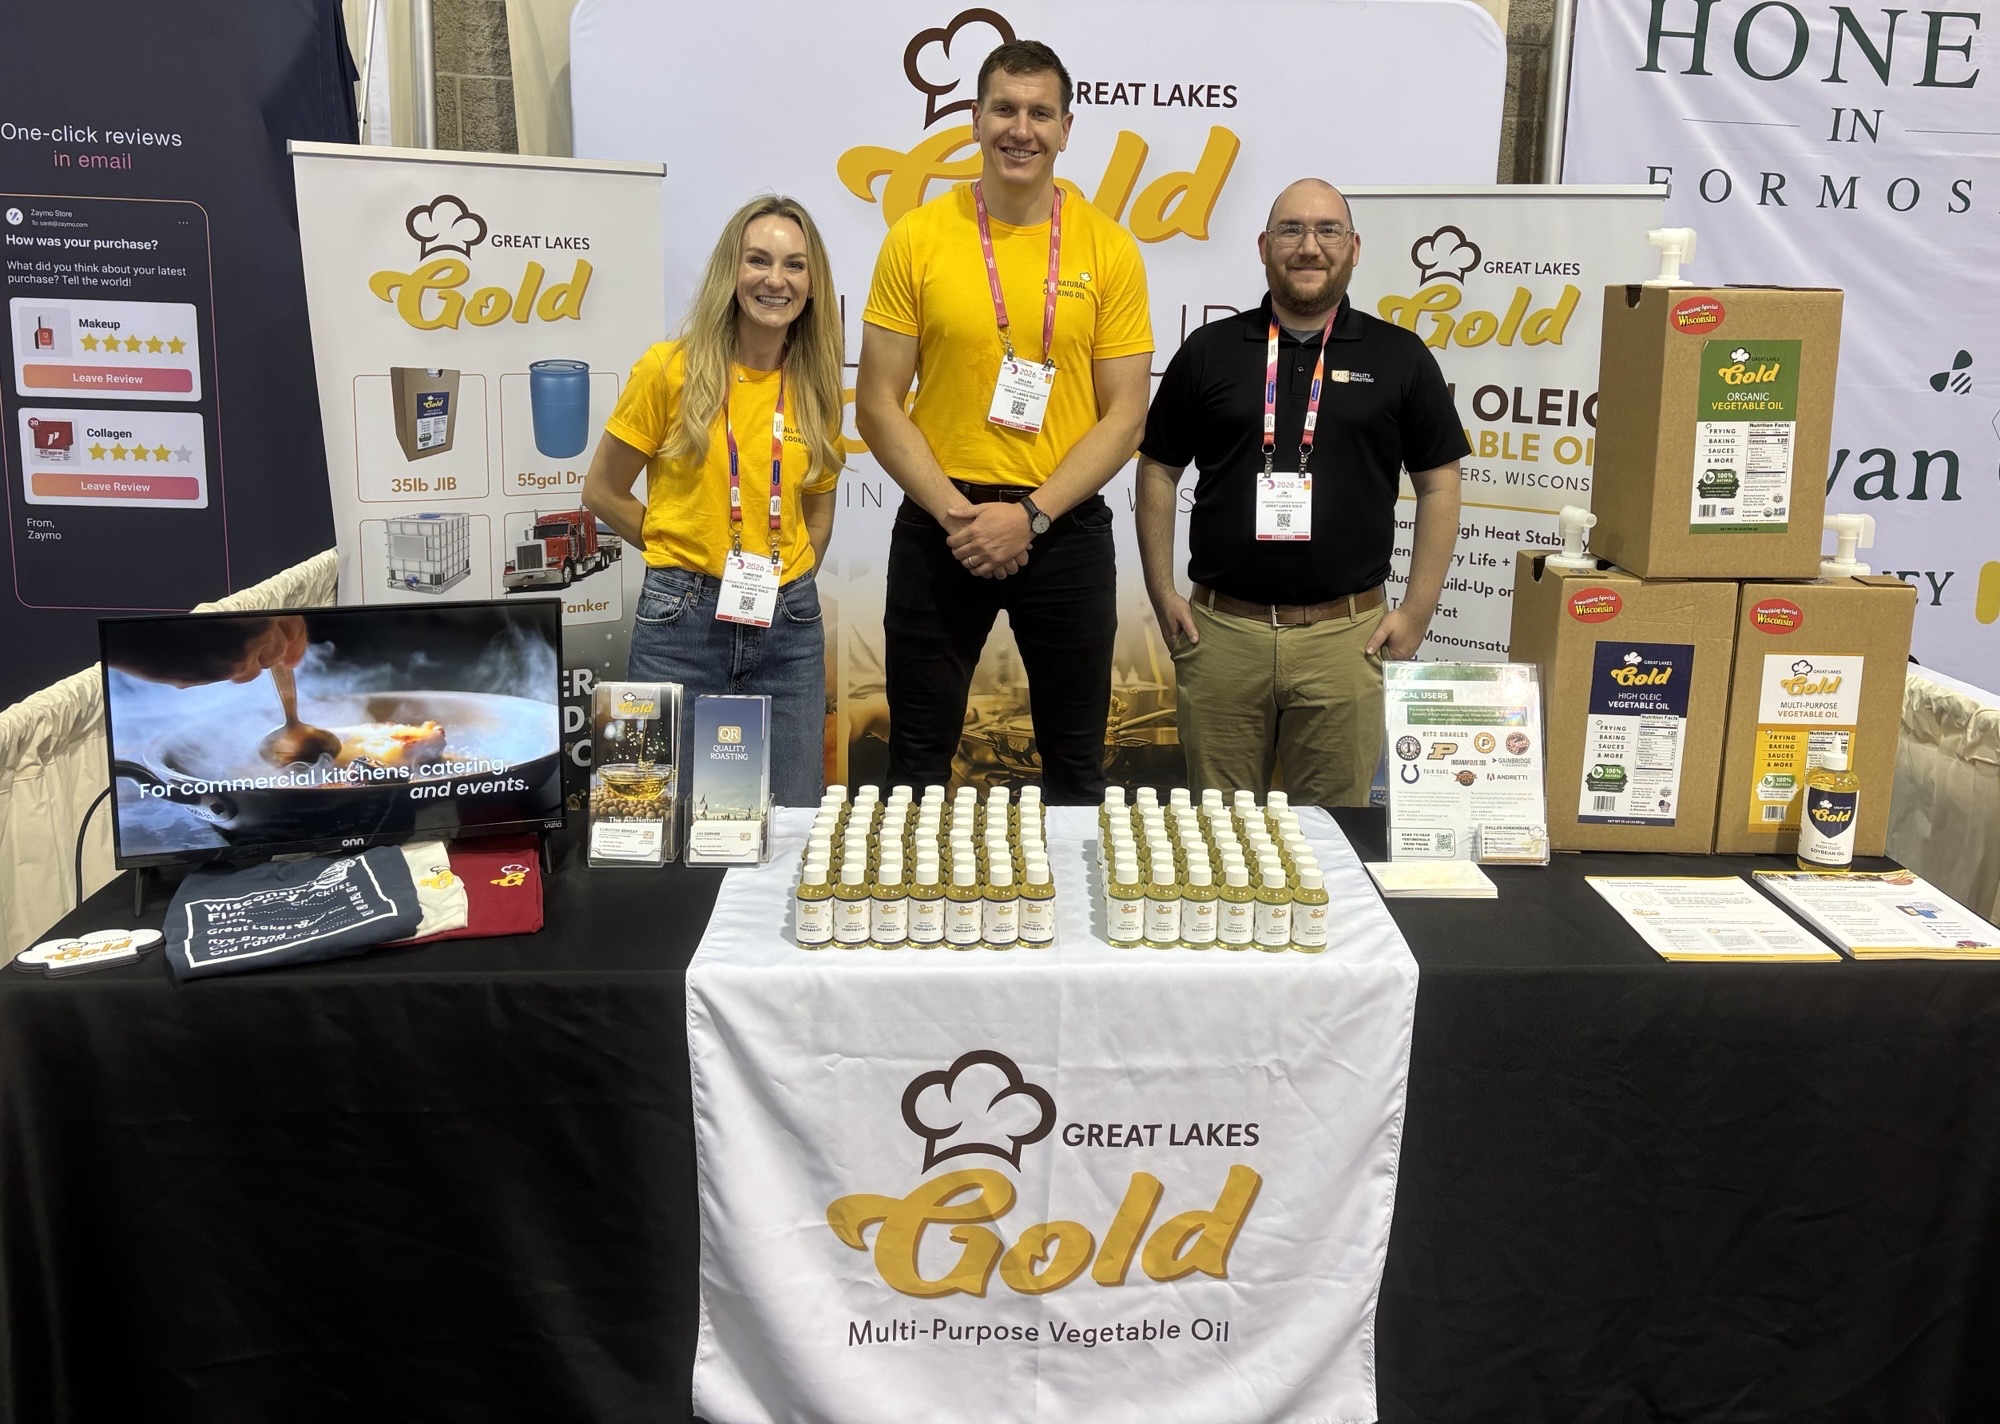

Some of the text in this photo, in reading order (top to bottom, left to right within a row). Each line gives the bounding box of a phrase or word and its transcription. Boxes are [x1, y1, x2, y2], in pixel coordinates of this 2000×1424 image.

[1635, 0, 1981, 89] HONE
[1072, 81, 1238, 109] REAT LAKES
[1826, 107, 1884, 144] IN
[1, 122, 183, 147] One-click reviews
[53, 150, 132, 169] in email
[836, 124, 1240, 243] Gld
[30, 208, 73, 219] Zaymo Store
[5, 234, 159, 250] How was your purchase?
[491, 234, 590, 250] GREAT LAKES
[6, 260, 187, 277] What did you think about your latest
[1483, 261, 1580, 276] GREAT LAKES
[7, 274, 132, 287] purchase? Tell the world!
[368, 257, 593, 331] Gold
[1043, 288, 1074, 299] CKING
[1701, 303, 1719, 311] Special
[1377, 283, 1581, 350] Gold
[1678, 314, 1718, 327] Wisconsin
[78, 318, 121, 331] Makeup
[72, 372, 143, 384] Leave Review
[1019, 368, 1037, 378] 2026
[1718, 363, 1780, 385] Gold
[1727, 392, 1770, 401] ORGANIC
[1711, 402, 1784, 410] VEGETABLE OIL
[86, 428, 132, 440] Collagen
[80, 481, 151, 492] Leave Review
[391, 476, 457, 492] 35lb JIB
[517, 471, 561, 490] 55gal
[1505, 471, 1590, 492] WISCONS
[26, 518, 55, 529] From,
[27, 530, 62, 542] Zaymo
[1484, 525, 1520, 542] Heat
[1469, 551, 1497, 567] Life
[746, 562, 765, 572] 2026
[1435, 603, 1458, 619] Fat
[1575, 604, 1614, 617] Wisconsin
[1757, 613, 1794, 627] Wisconsin
[1424, 629, 1510, 653] Monounsatu
[1610, 666, 1673, 686] Gold
[1780, 675, 1842, 696] Gold
[1421, 692, 1448, 700] USERS
[1618, 692, 1662, 701] HIGH OLEIC
[617, 700, 655, 715] Gold
[1608, 701, 1670, 710] VEGETABLE OIL
[1780, 701, 1838, 710] MULTI-PURPOSE
[1778, 710, 1823, 718] VEGETABLE
[719, 728, 740, 742] QR
[712, 744, 746, 753] QUALITY
[710, 752, 748, 761] ROASTING
[138, 756, 511, 799] For commercial kitchens, catering,
[409, 778, 530, 800] and events.
[608, 816, 622, 824] The
[1811, 808, 1852, 822] Gold
[544, 821, 563, 829] VIZIO
[341, 837, 364, 847] onn
[206, 923, 294, 936] Great Lakes
[44, 939, 133, 961] Gold
[1062, 1122, 1259, 1148] GREAT LAKES
[825, 1163, 1262, 1298] Gold
[848, 1318, 1230, 1348] Multi-Purpose Vegetable Oil
